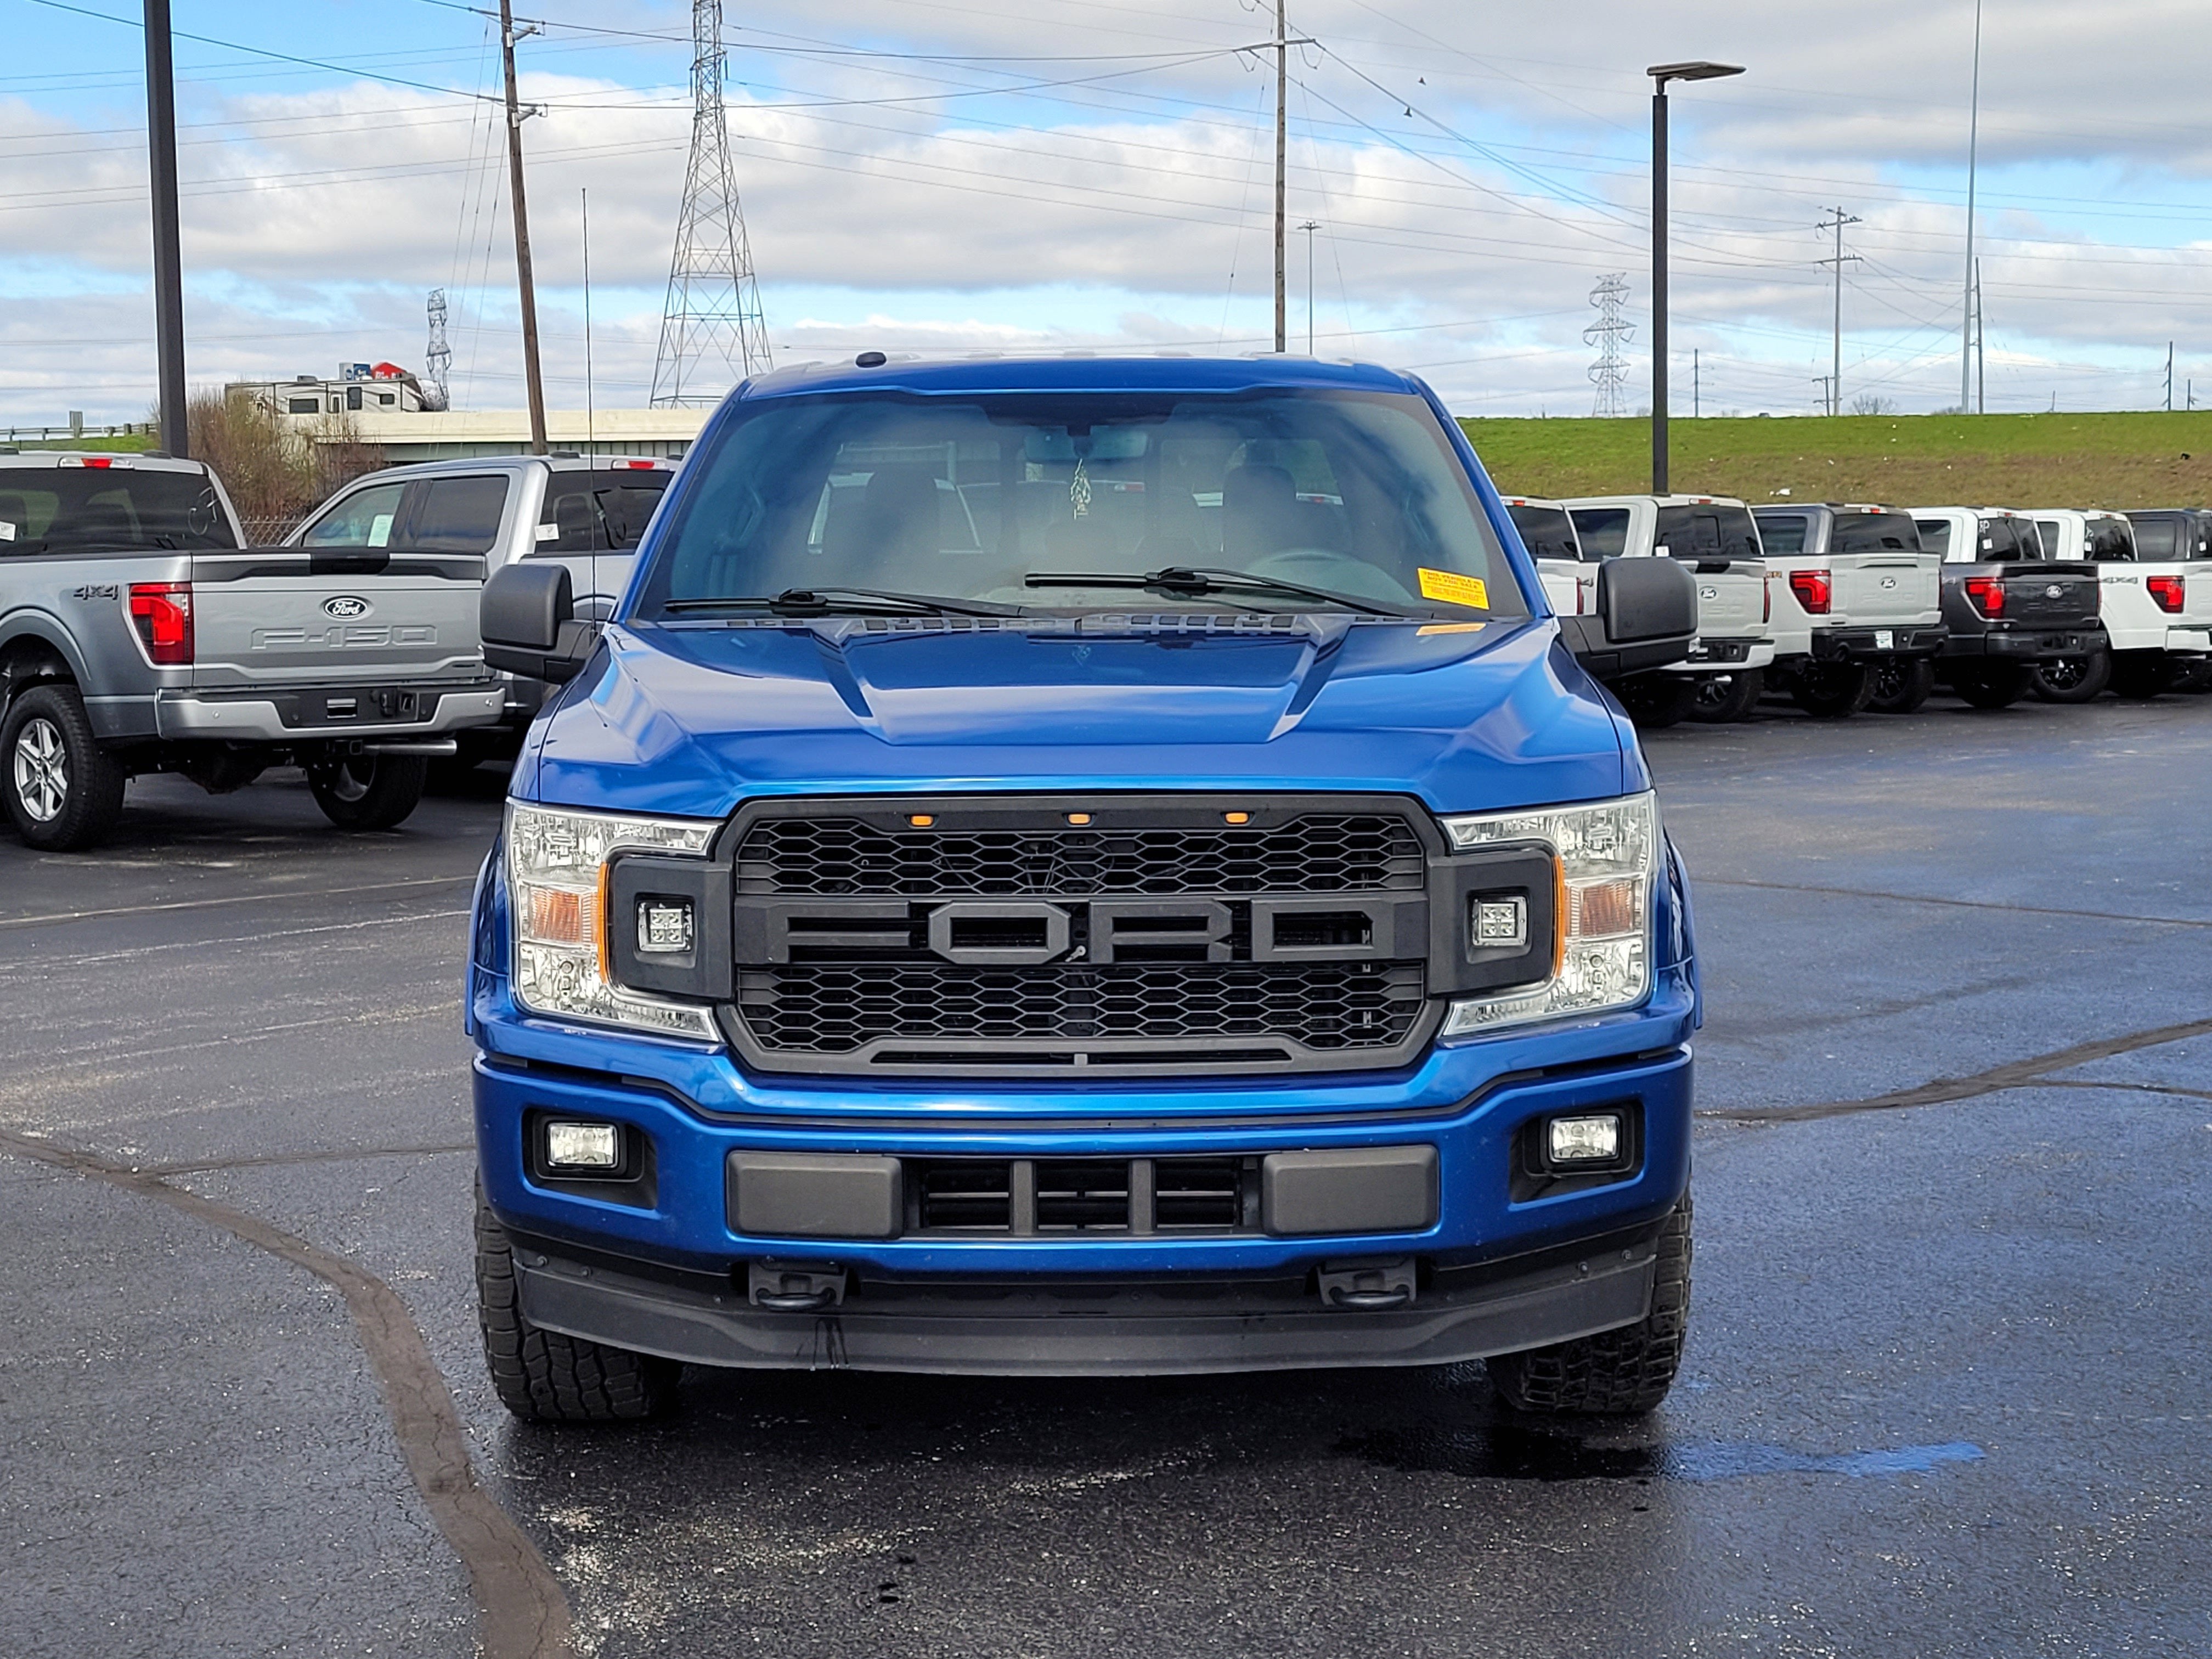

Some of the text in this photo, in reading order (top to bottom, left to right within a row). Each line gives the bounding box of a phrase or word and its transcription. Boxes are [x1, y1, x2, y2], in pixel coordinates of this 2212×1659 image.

[331, 600, 361, 616] Ford
[251, 626, 437, 650] F-150
[767, 900, 1395, 964] FORD
